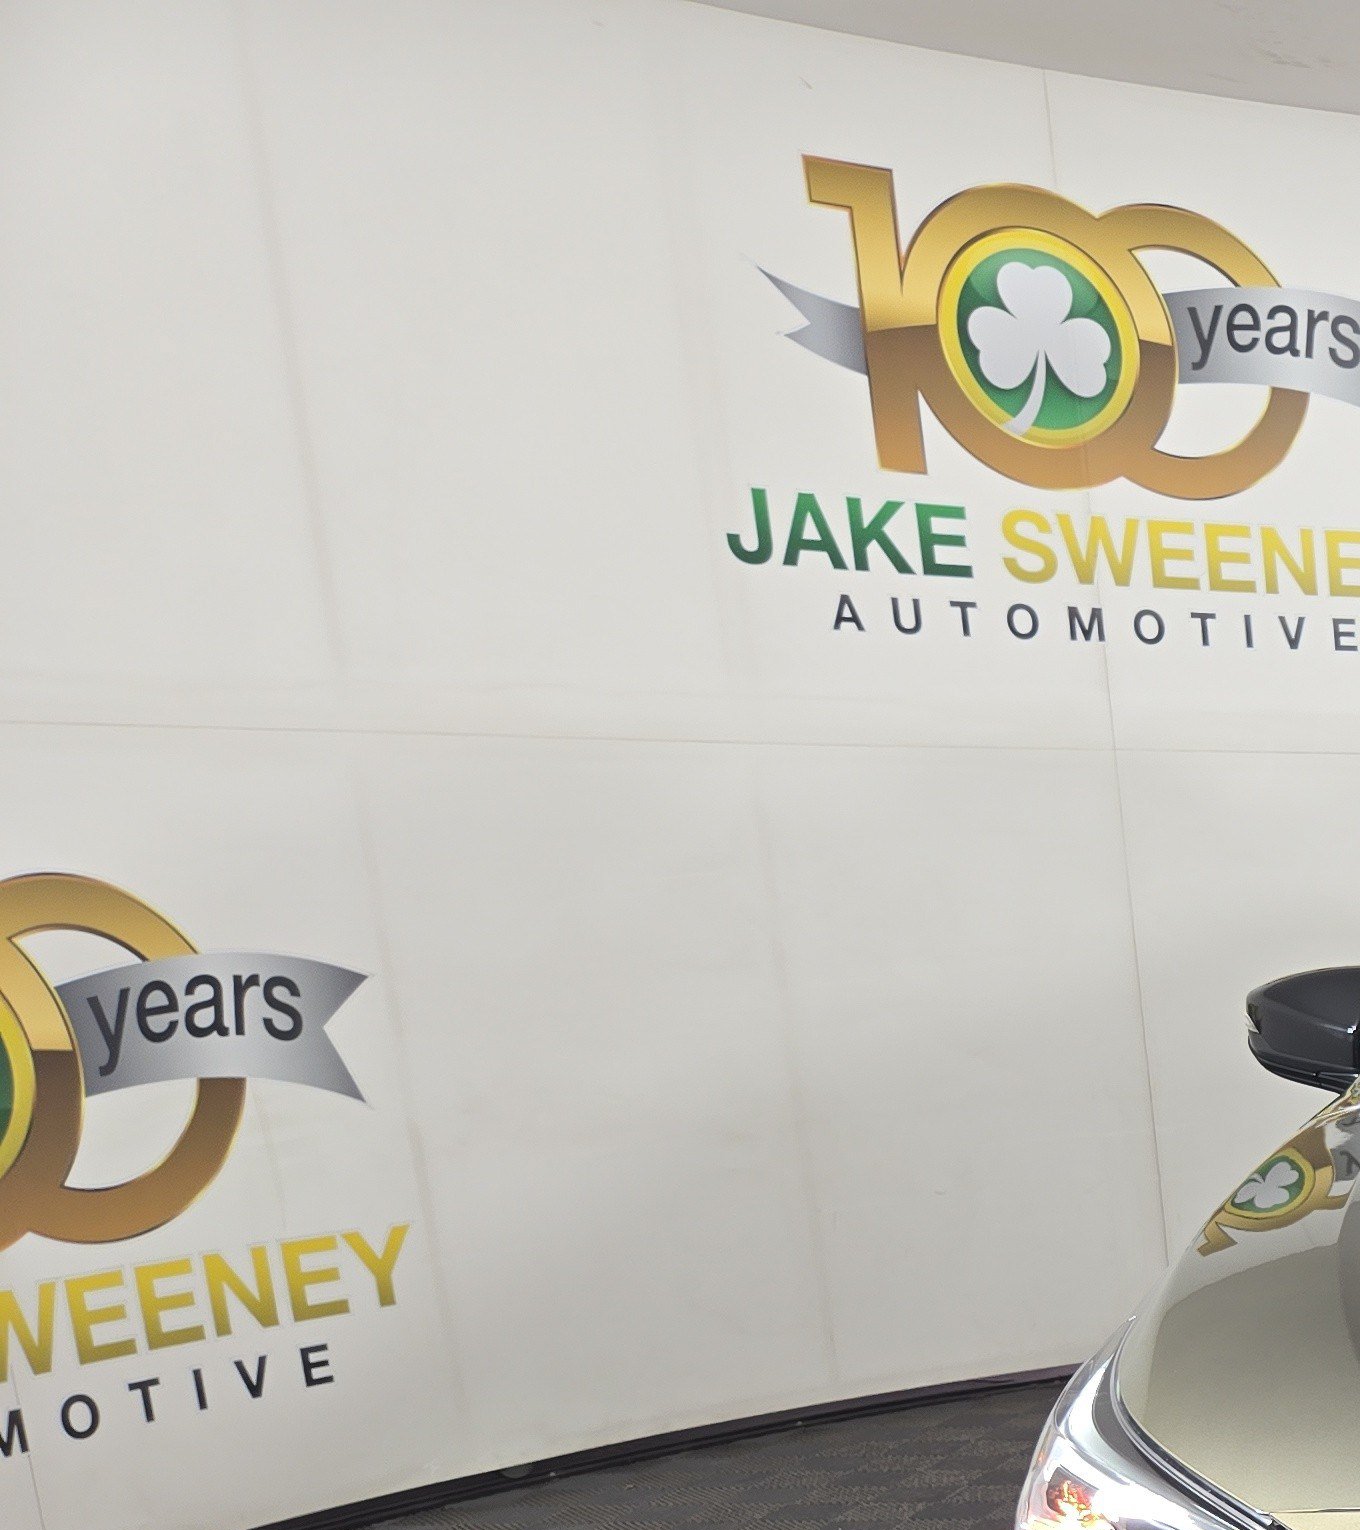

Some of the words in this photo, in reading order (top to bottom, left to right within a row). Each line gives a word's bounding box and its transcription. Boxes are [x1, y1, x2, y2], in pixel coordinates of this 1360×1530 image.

[801, 154, 1308, 501] 100
[727, 487, 975, 579] JAKE
[832, 593, 1359, 652] AUTOMOTIVE
[86, 973, 304, 1077] years
